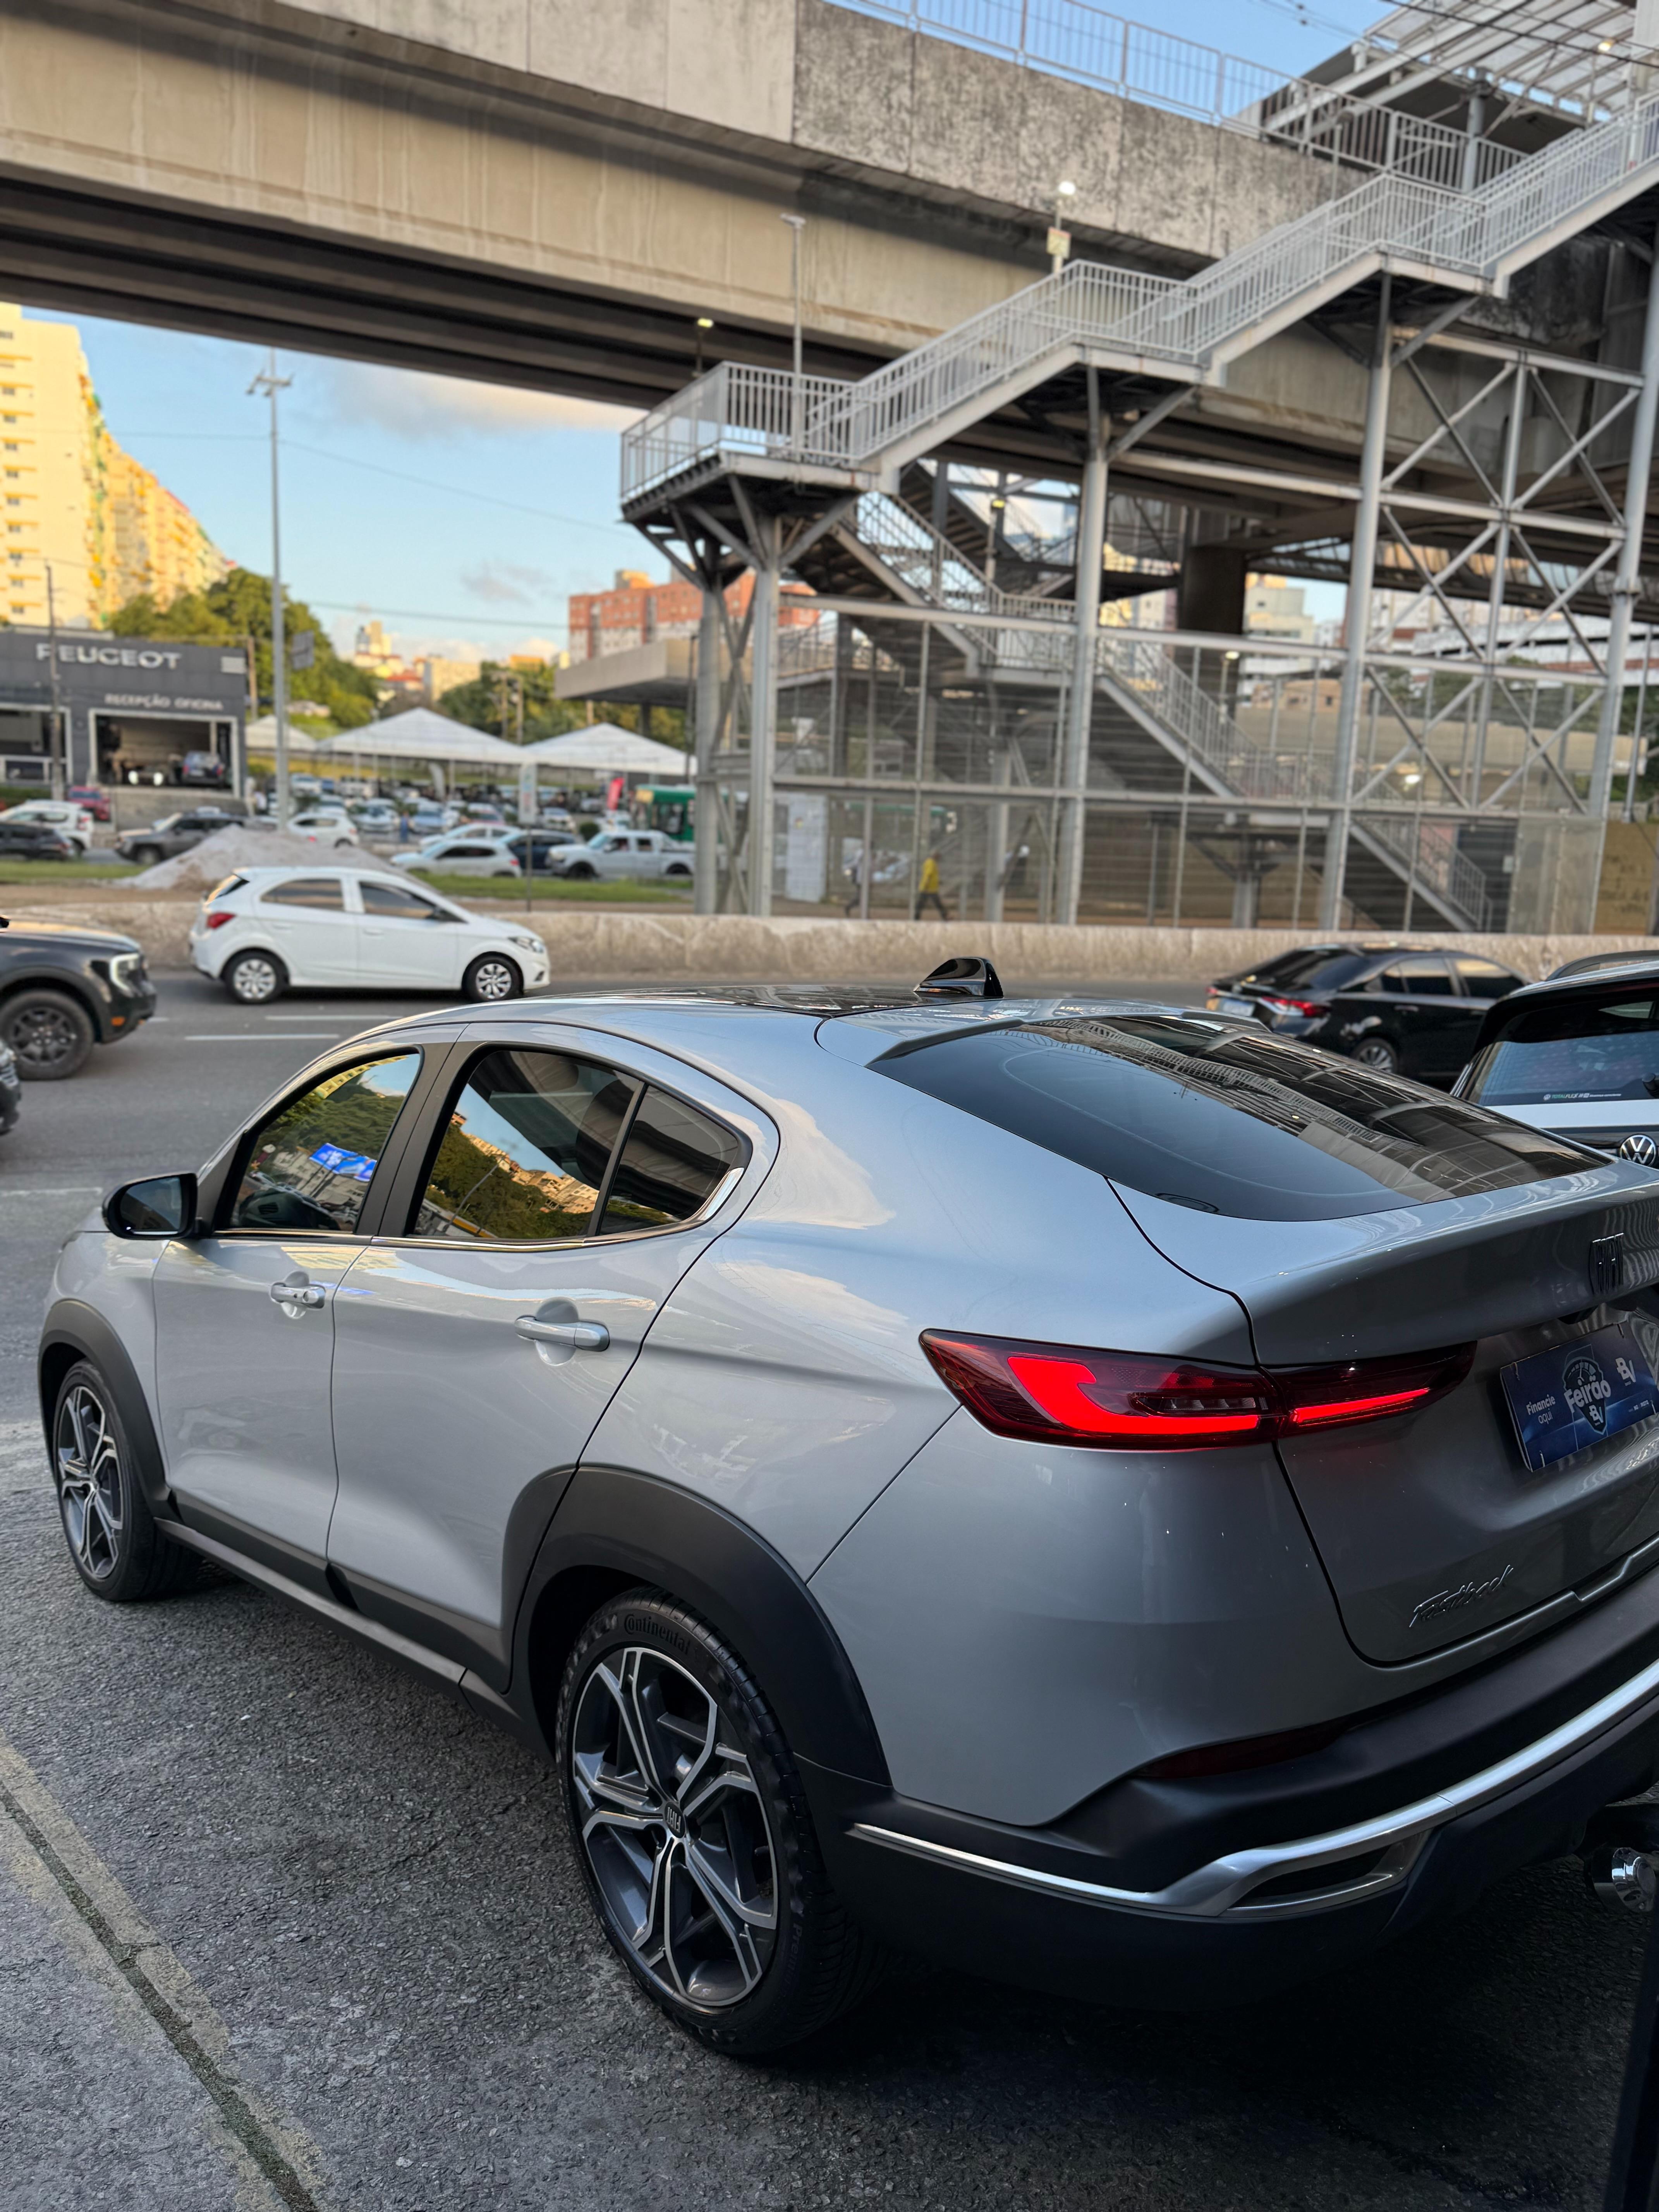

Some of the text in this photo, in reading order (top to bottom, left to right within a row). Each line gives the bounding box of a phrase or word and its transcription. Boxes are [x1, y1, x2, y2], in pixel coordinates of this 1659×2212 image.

[1526, 1394, 1556, 1415] Financie
[1538, 1408, 1553, 1425] aqui
[624, 1614, 690, 1655] Continental
